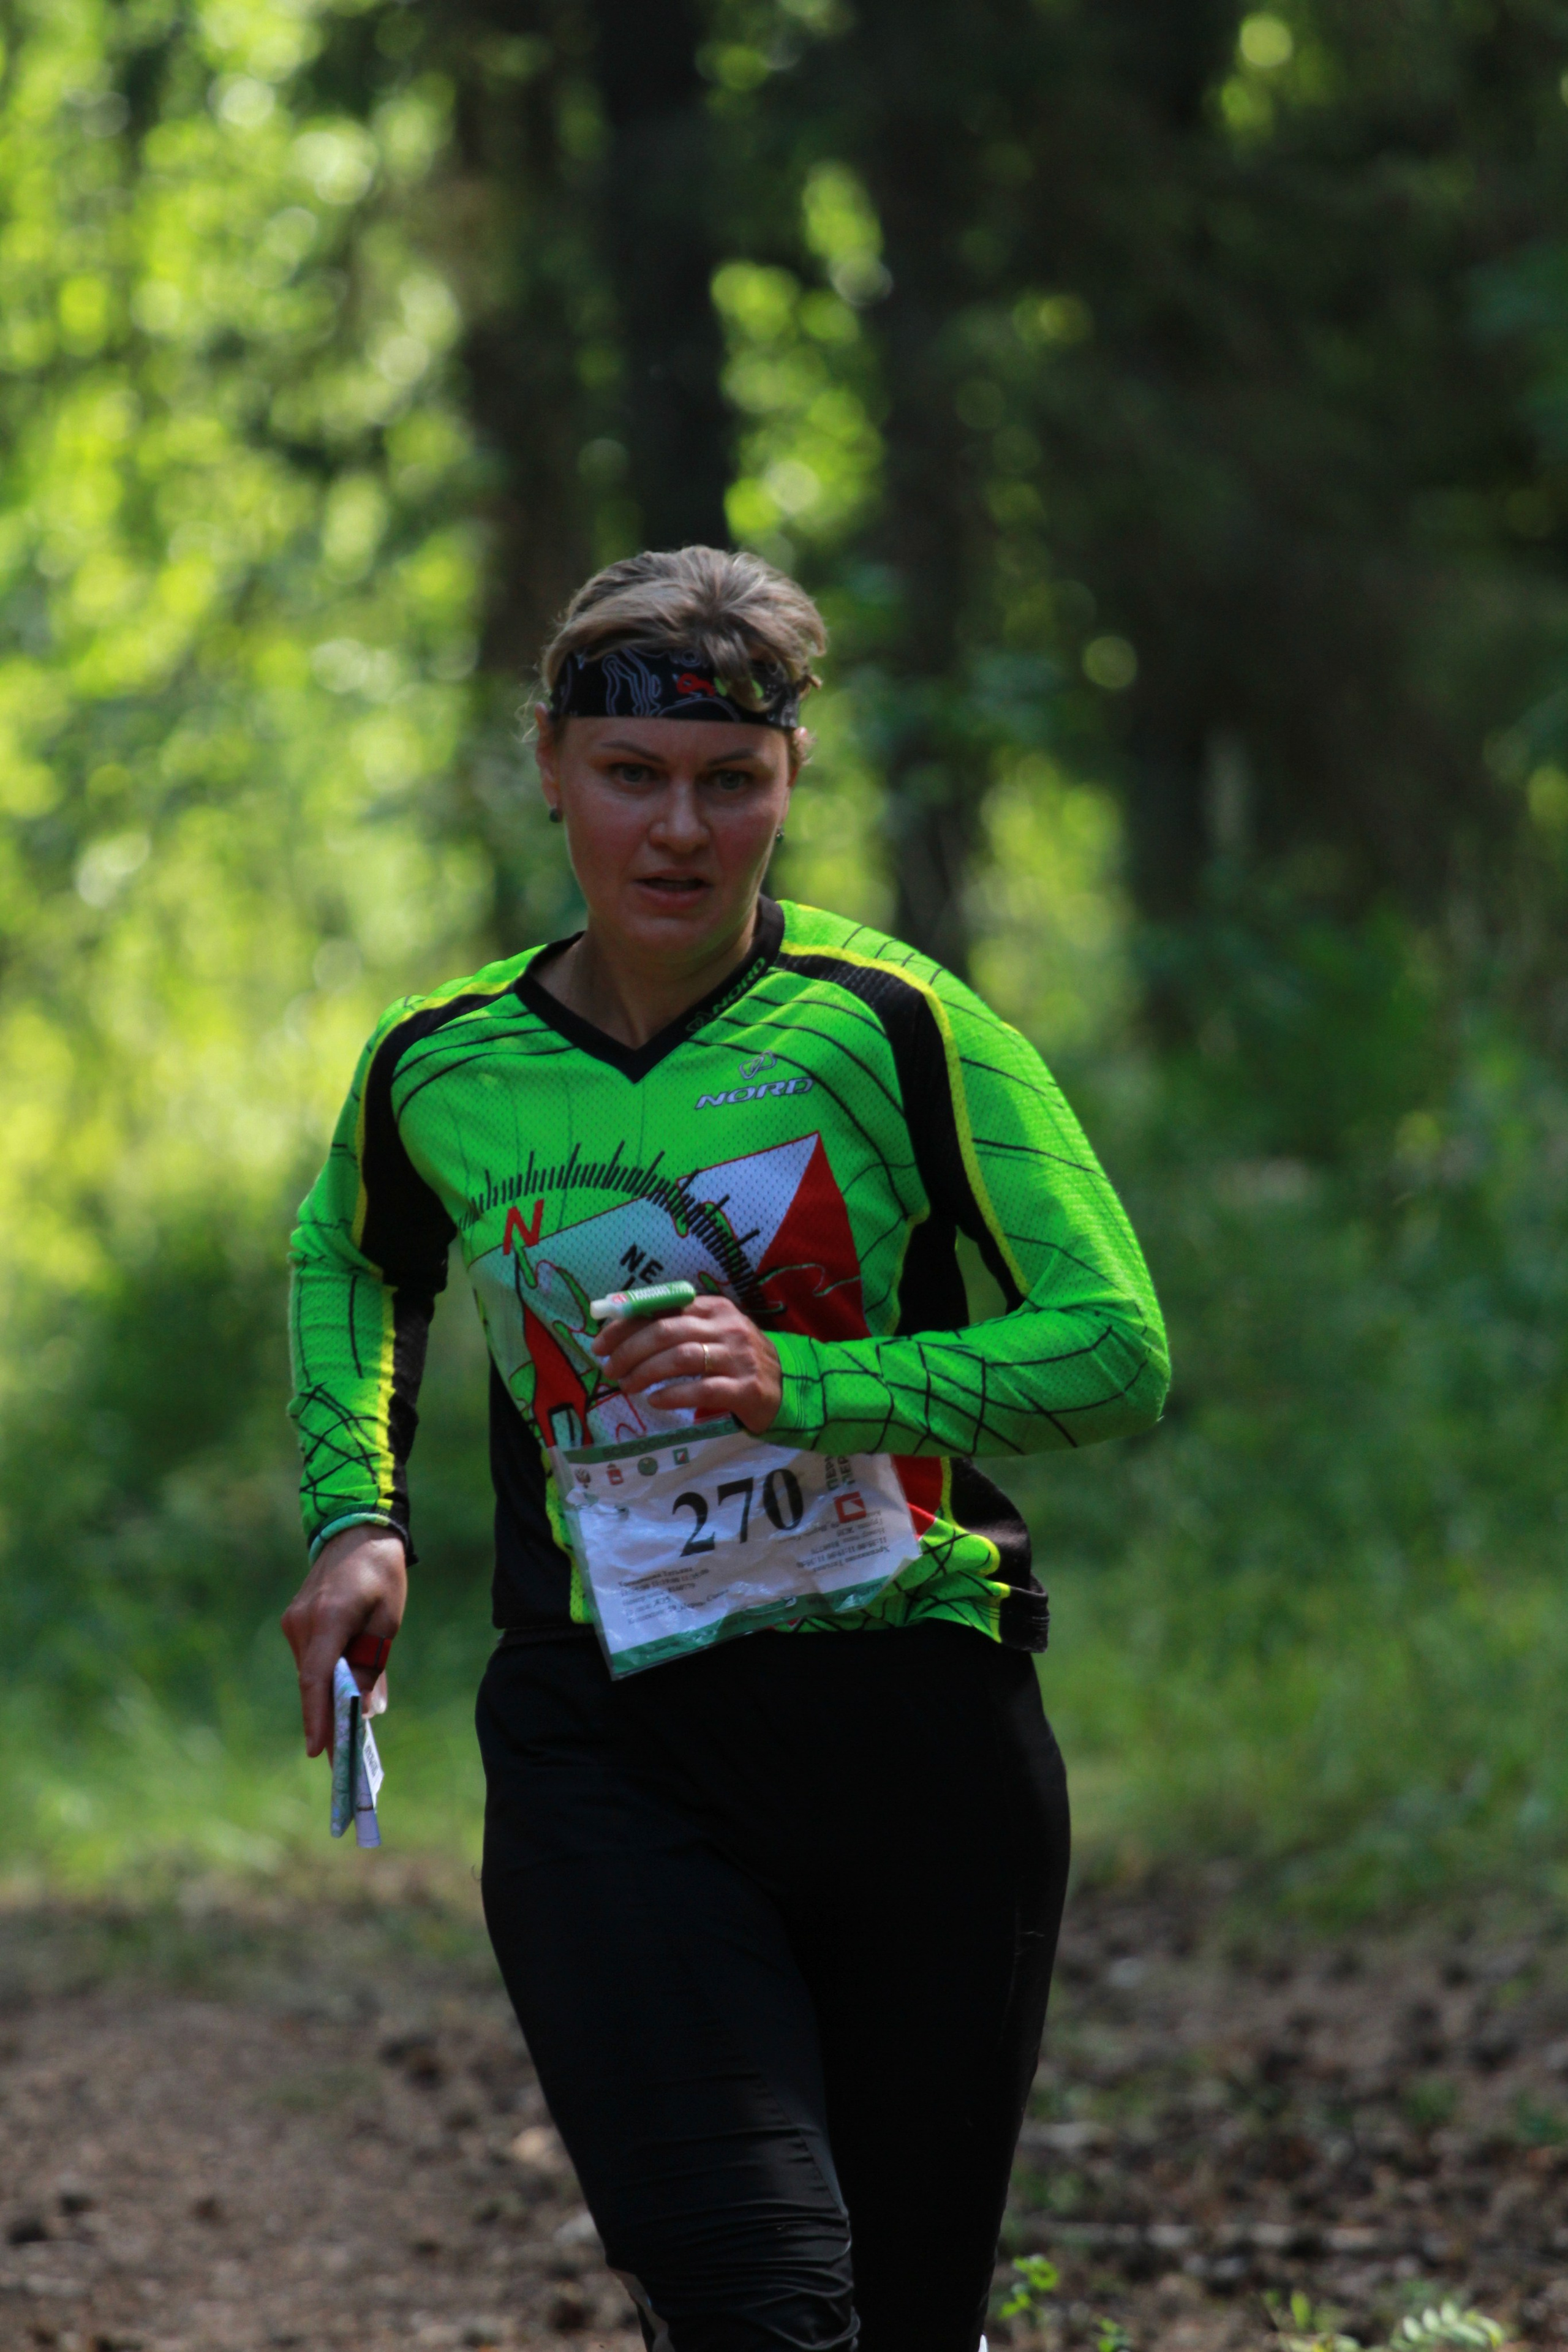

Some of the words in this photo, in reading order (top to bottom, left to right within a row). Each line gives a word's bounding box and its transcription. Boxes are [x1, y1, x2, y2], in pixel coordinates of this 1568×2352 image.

[712, 957, 766, 1014] NORD
[694, 1077, 815, 1110] NORD
[503, 1199, 544, 1256] N
[620, 1241, 663, 1284] NE
[672, 1468, 804, 1558] 270
